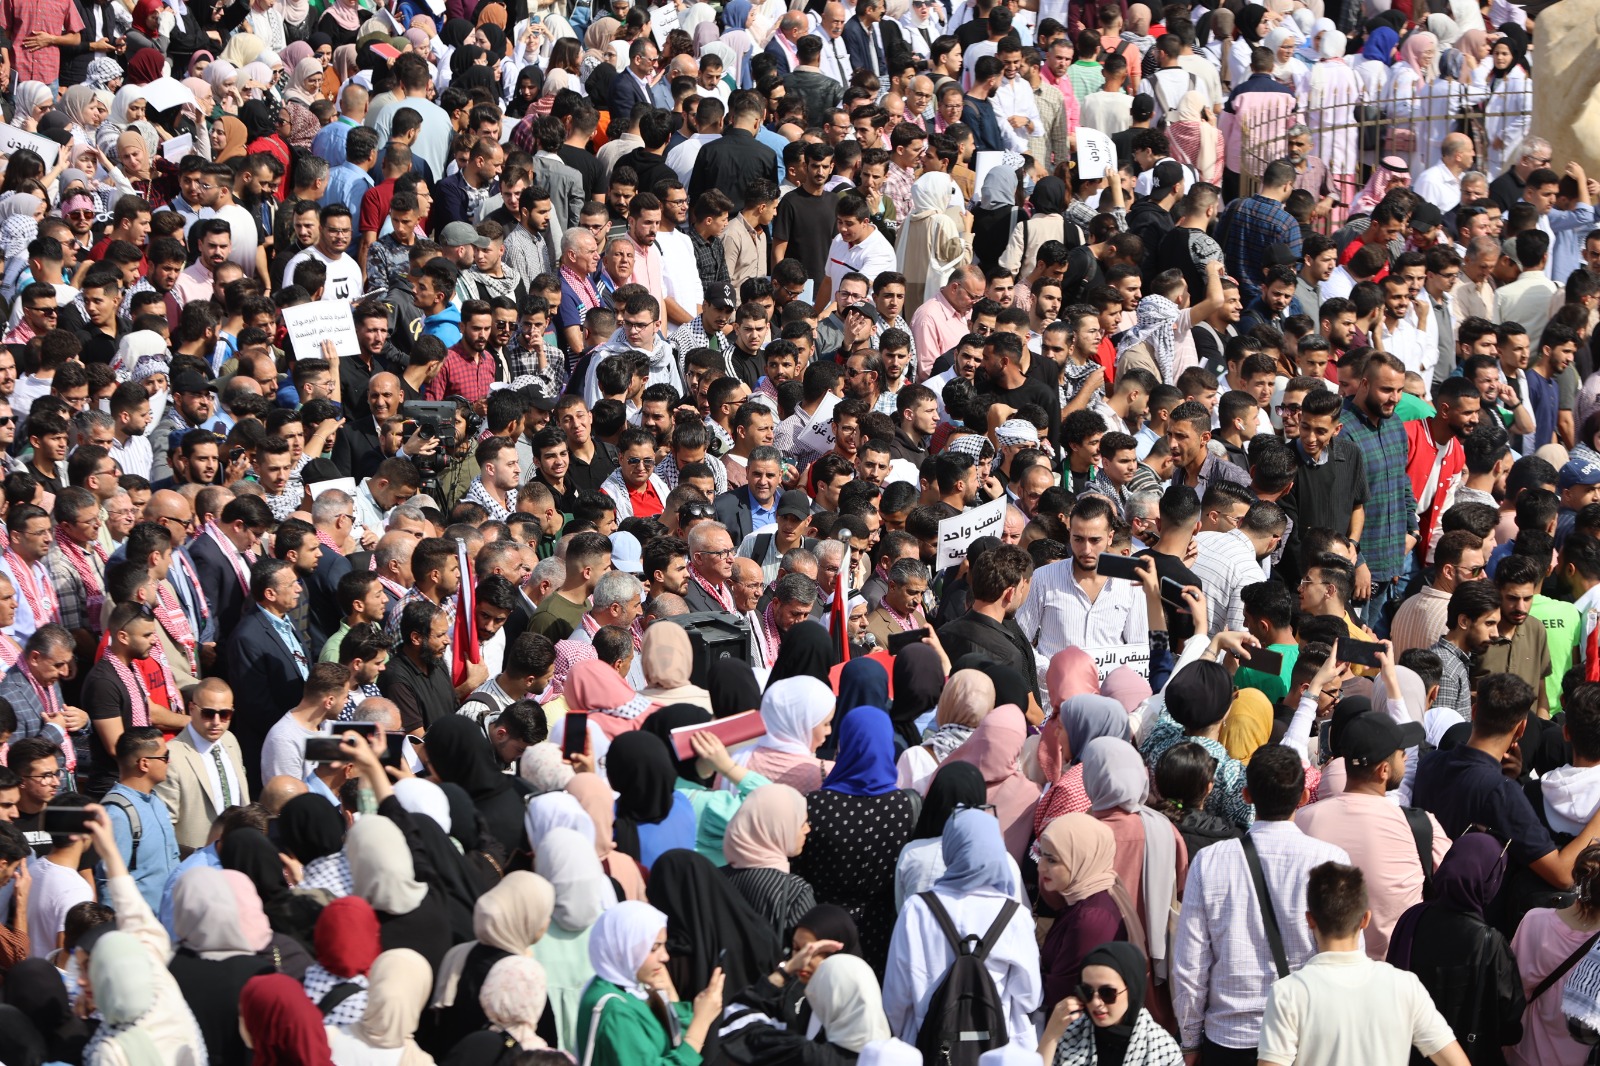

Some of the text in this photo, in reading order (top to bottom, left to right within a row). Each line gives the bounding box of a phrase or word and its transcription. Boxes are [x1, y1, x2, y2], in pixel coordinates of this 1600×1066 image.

[943, 526, 971, 542] واحد
[1541, 618, 1565, 629] EER
[1094, 650, 1116, 667] الأرد
